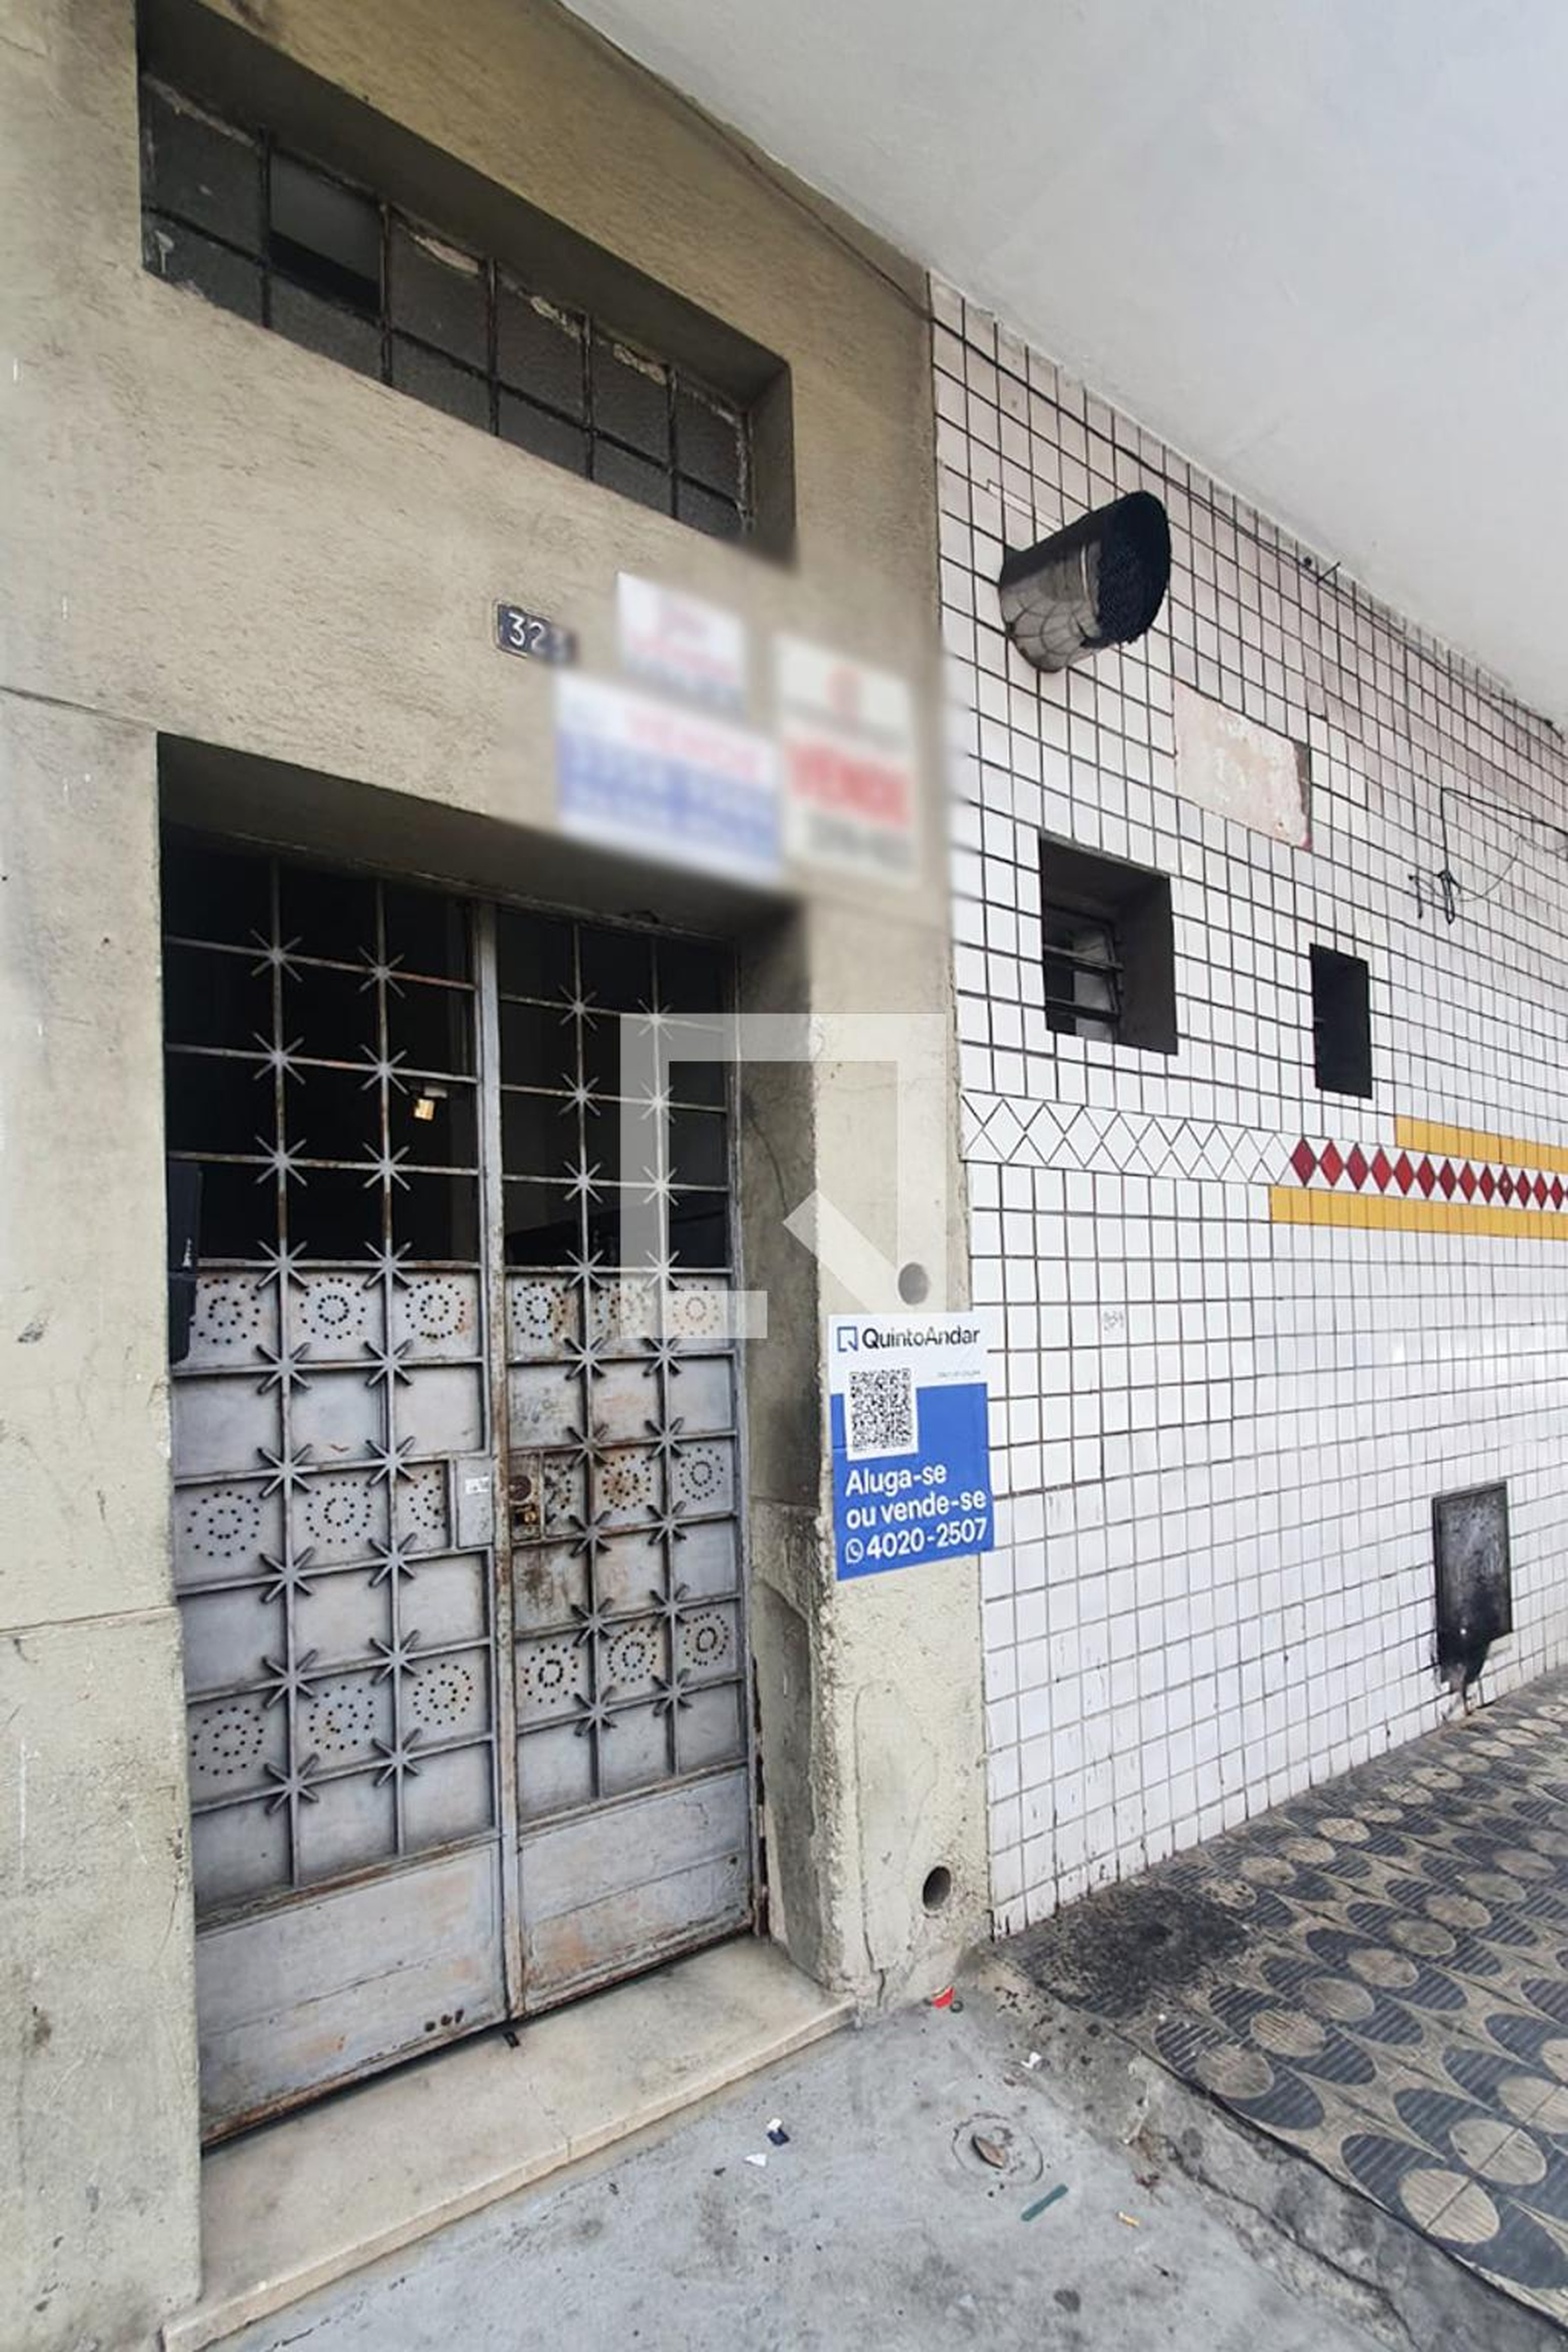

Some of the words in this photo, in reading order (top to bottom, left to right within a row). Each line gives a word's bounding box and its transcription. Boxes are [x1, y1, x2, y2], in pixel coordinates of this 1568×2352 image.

[509, 612, 564, 661] 32
[862, 1325, 980, 1349] QuintoAndar
[845, 1465, 947, 1497] Aluga-se
[846, 1507, 876, 1529] ou
[880, 1490, 986, 1524] vende-se
[866, 1517, 987, 1559] 4020-2507
